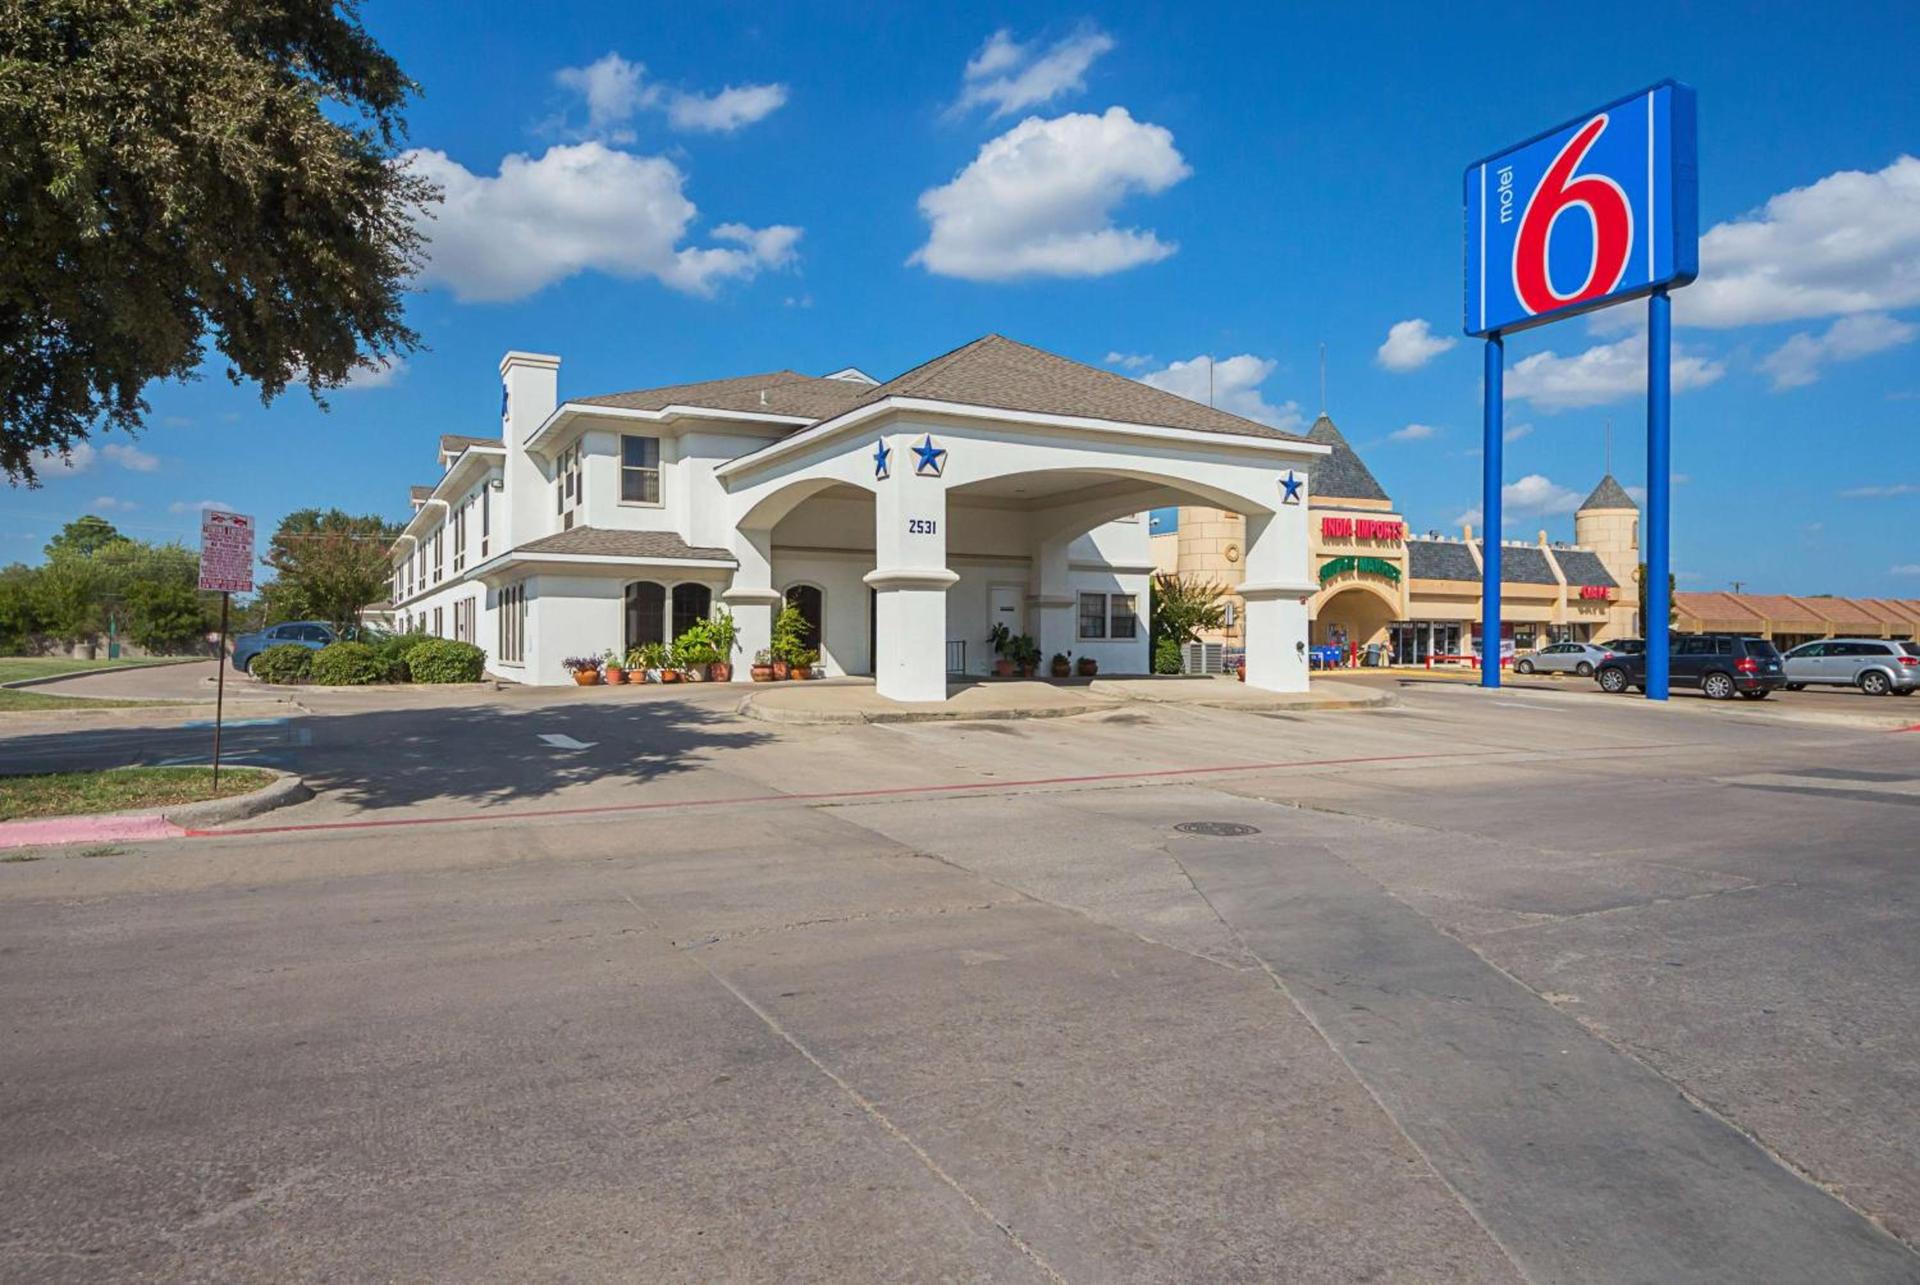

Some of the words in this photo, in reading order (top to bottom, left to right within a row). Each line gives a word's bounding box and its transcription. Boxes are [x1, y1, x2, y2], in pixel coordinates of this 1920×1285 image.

[1497, 165, 1513, 224] motel
[1512, 113, 1634, 315] 6
[909, 519, 936, 535] 2531
[1322, 517, 1353, 537] INDIA
[1355, 518, 1403, 540] IMPORTS
